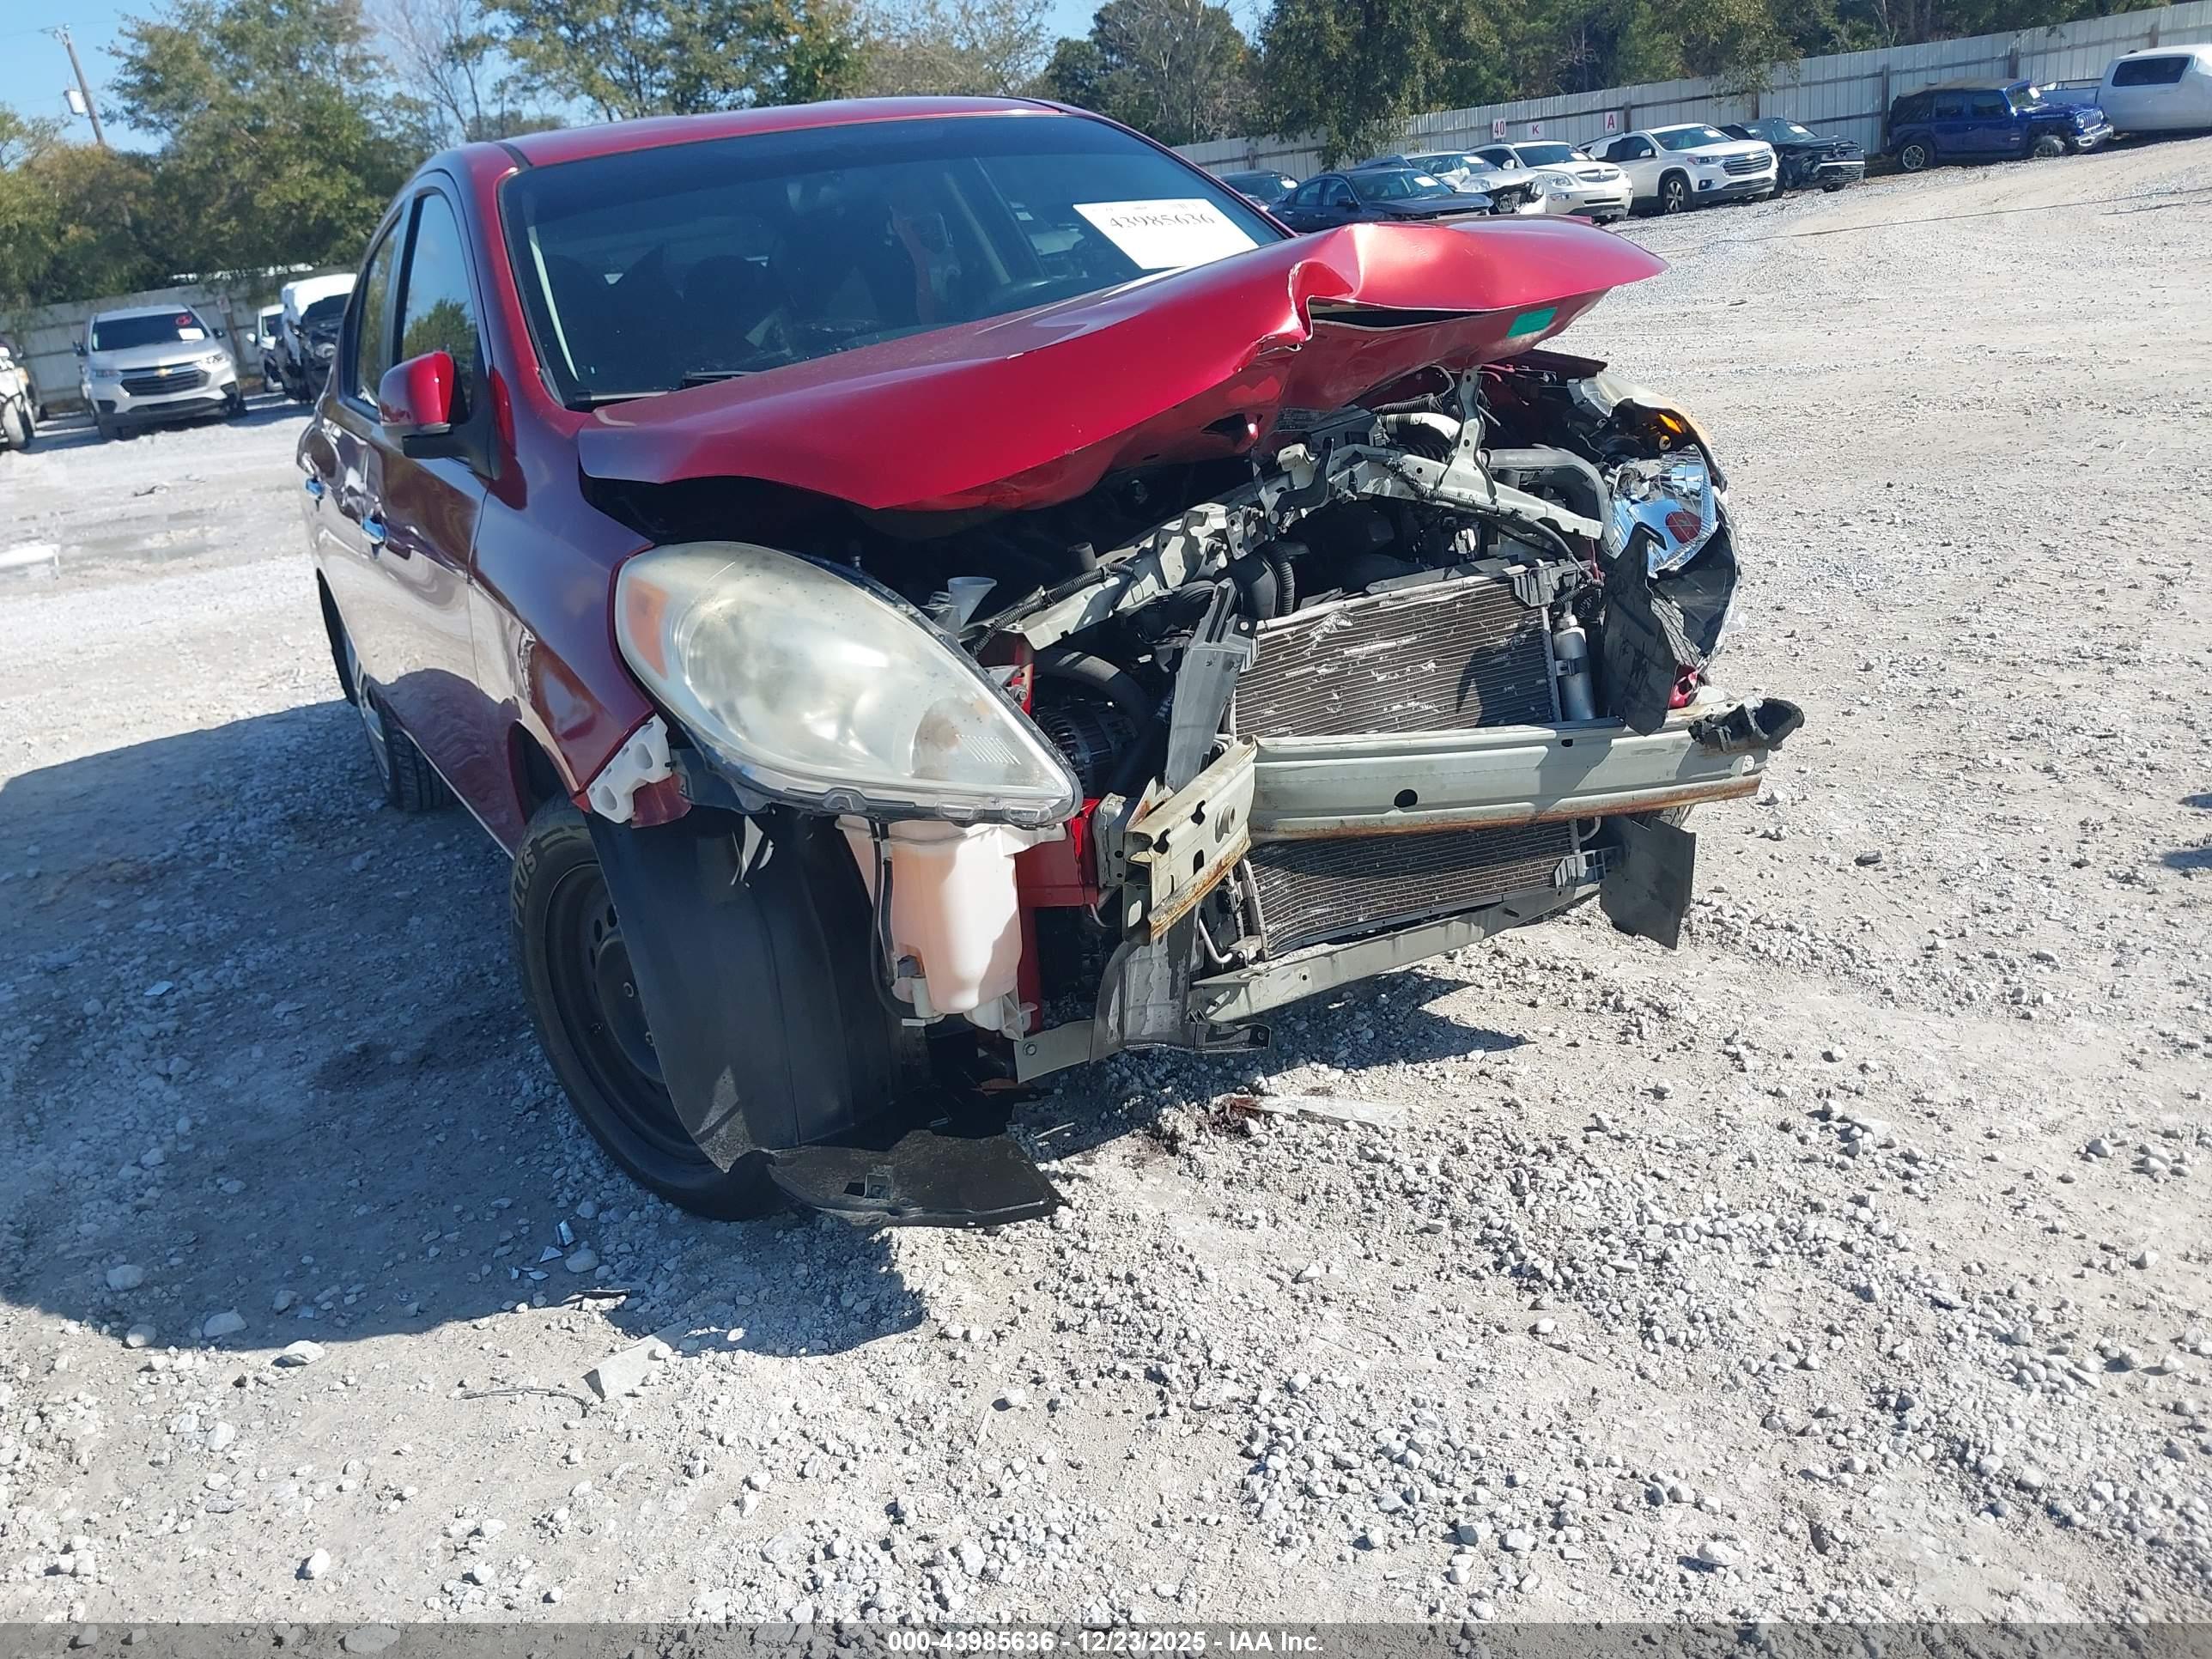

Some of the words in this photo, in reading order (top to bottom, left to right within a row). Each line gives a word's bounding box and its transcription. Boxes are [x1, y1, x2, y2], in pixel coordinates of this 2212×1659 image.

[1494, 120, 1505, 136] 40
[1607, 113, 1615, 129] A
[1532, 125, 1540, 135] K
[1109, 213, 1215, 228] 43985636
[514, 845, 538, 928] PLUS
